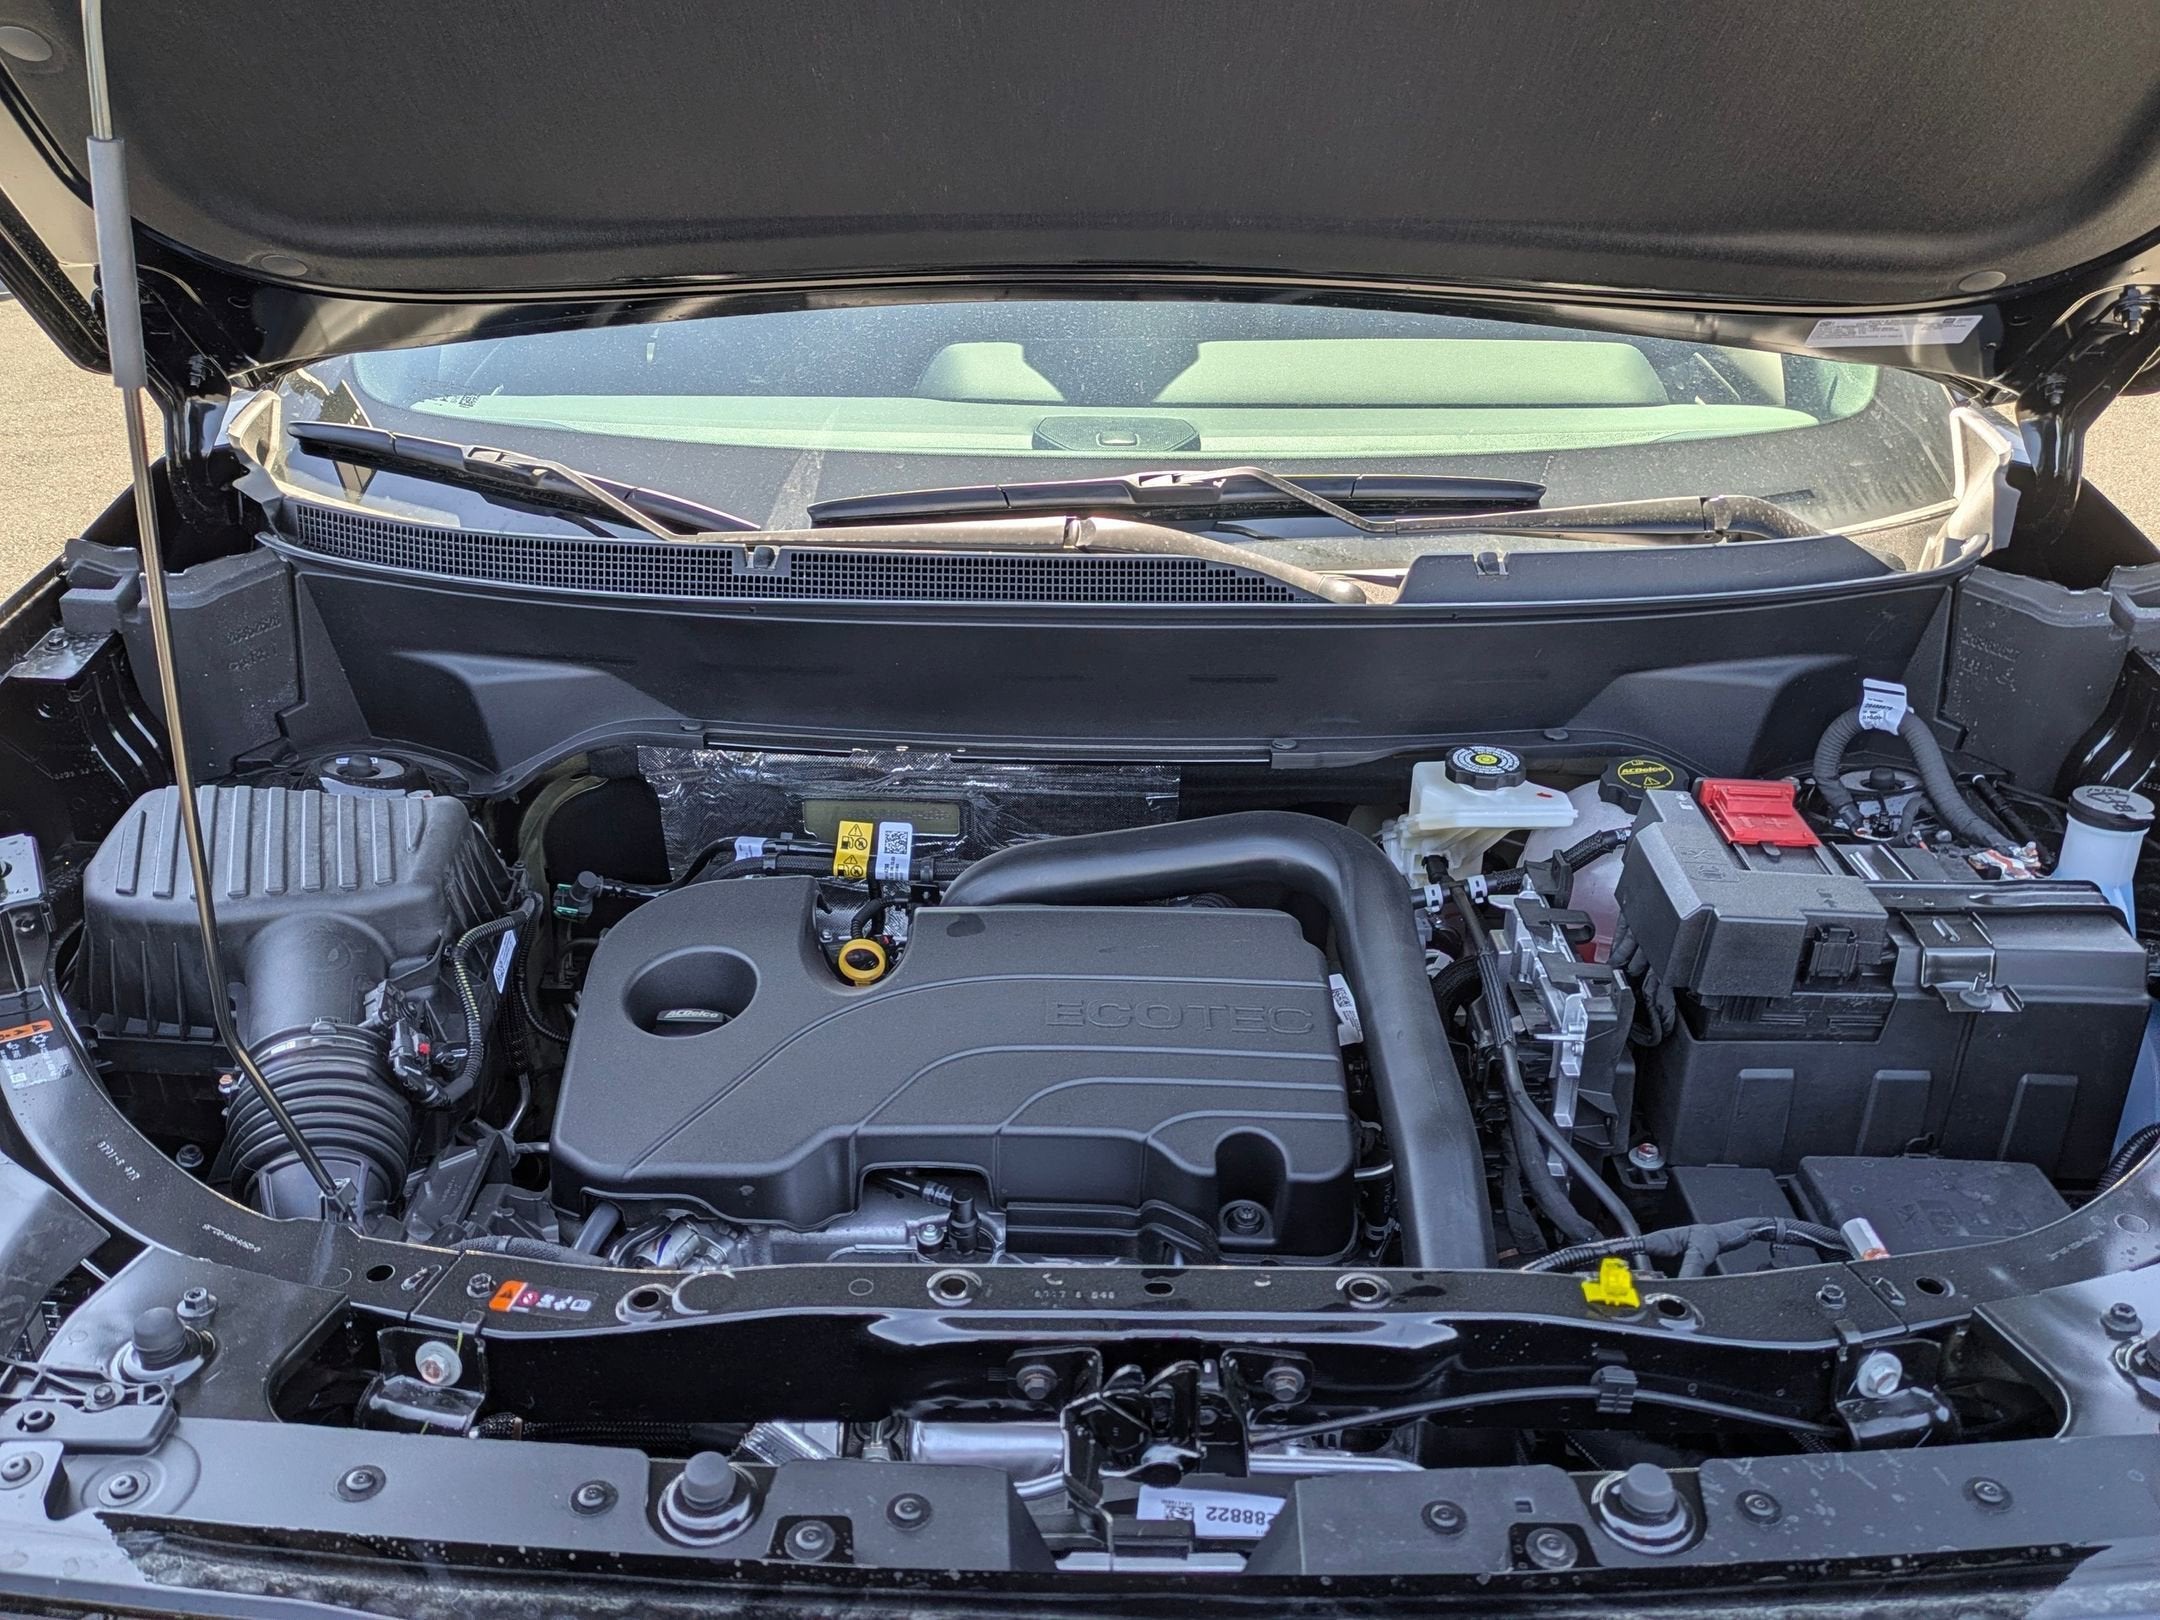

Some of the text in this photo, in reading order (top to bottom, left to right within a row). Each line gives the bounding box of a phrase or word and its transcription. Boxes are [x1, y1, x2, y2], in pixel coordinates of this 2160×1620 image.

[1620, 766, 1665, 776] ACDelco
[664, 1009, 719, 1019] ACDelco
[1046, 999, 1314, 1034] ECOTEC
